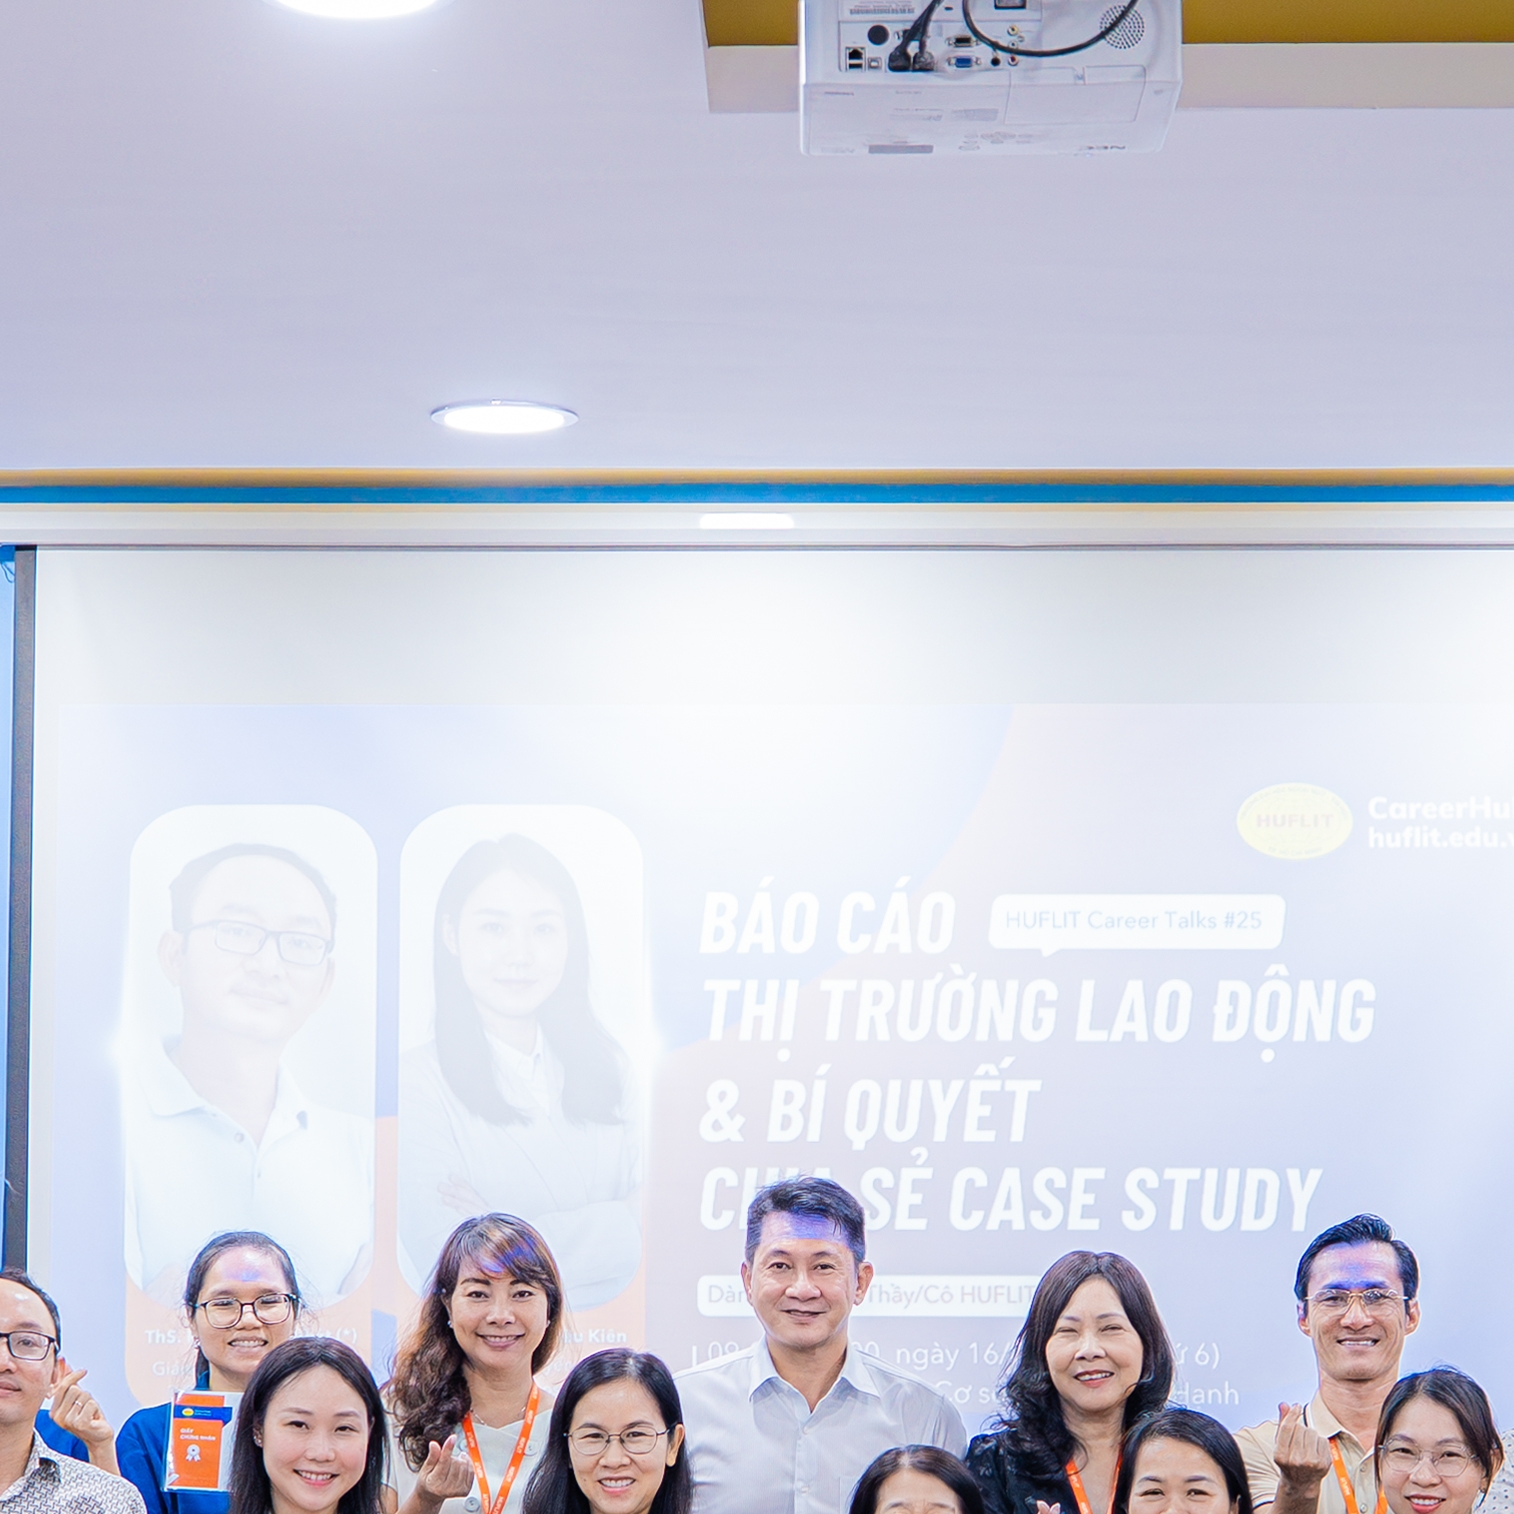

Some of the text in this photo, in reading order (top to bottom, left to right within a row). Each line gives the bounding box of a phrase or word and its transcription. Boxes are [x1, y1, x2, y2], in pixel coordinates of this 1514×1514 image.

[1256, 812, 1333, 828] HUFLIT
[699, 876, 956, 954] BÁO CÁO
[1005, 909, 1262, 930] HUFLIT Career Talks #25
[703, 963, 1377, 1063] THỊ TRƯỜNG LAO ĐỘNG
[698, 1056, 1043, 1151] & BÍ QUYẾT
[859, 1146, 935, 1232] SẺ
[949, 1166, 1106, 1232] CASE
[1120, 1166, 1324, 1232] STUDY
[588, 1328, 627, 1343] Kiên
[896, 1341, 959, 1370] ngày
